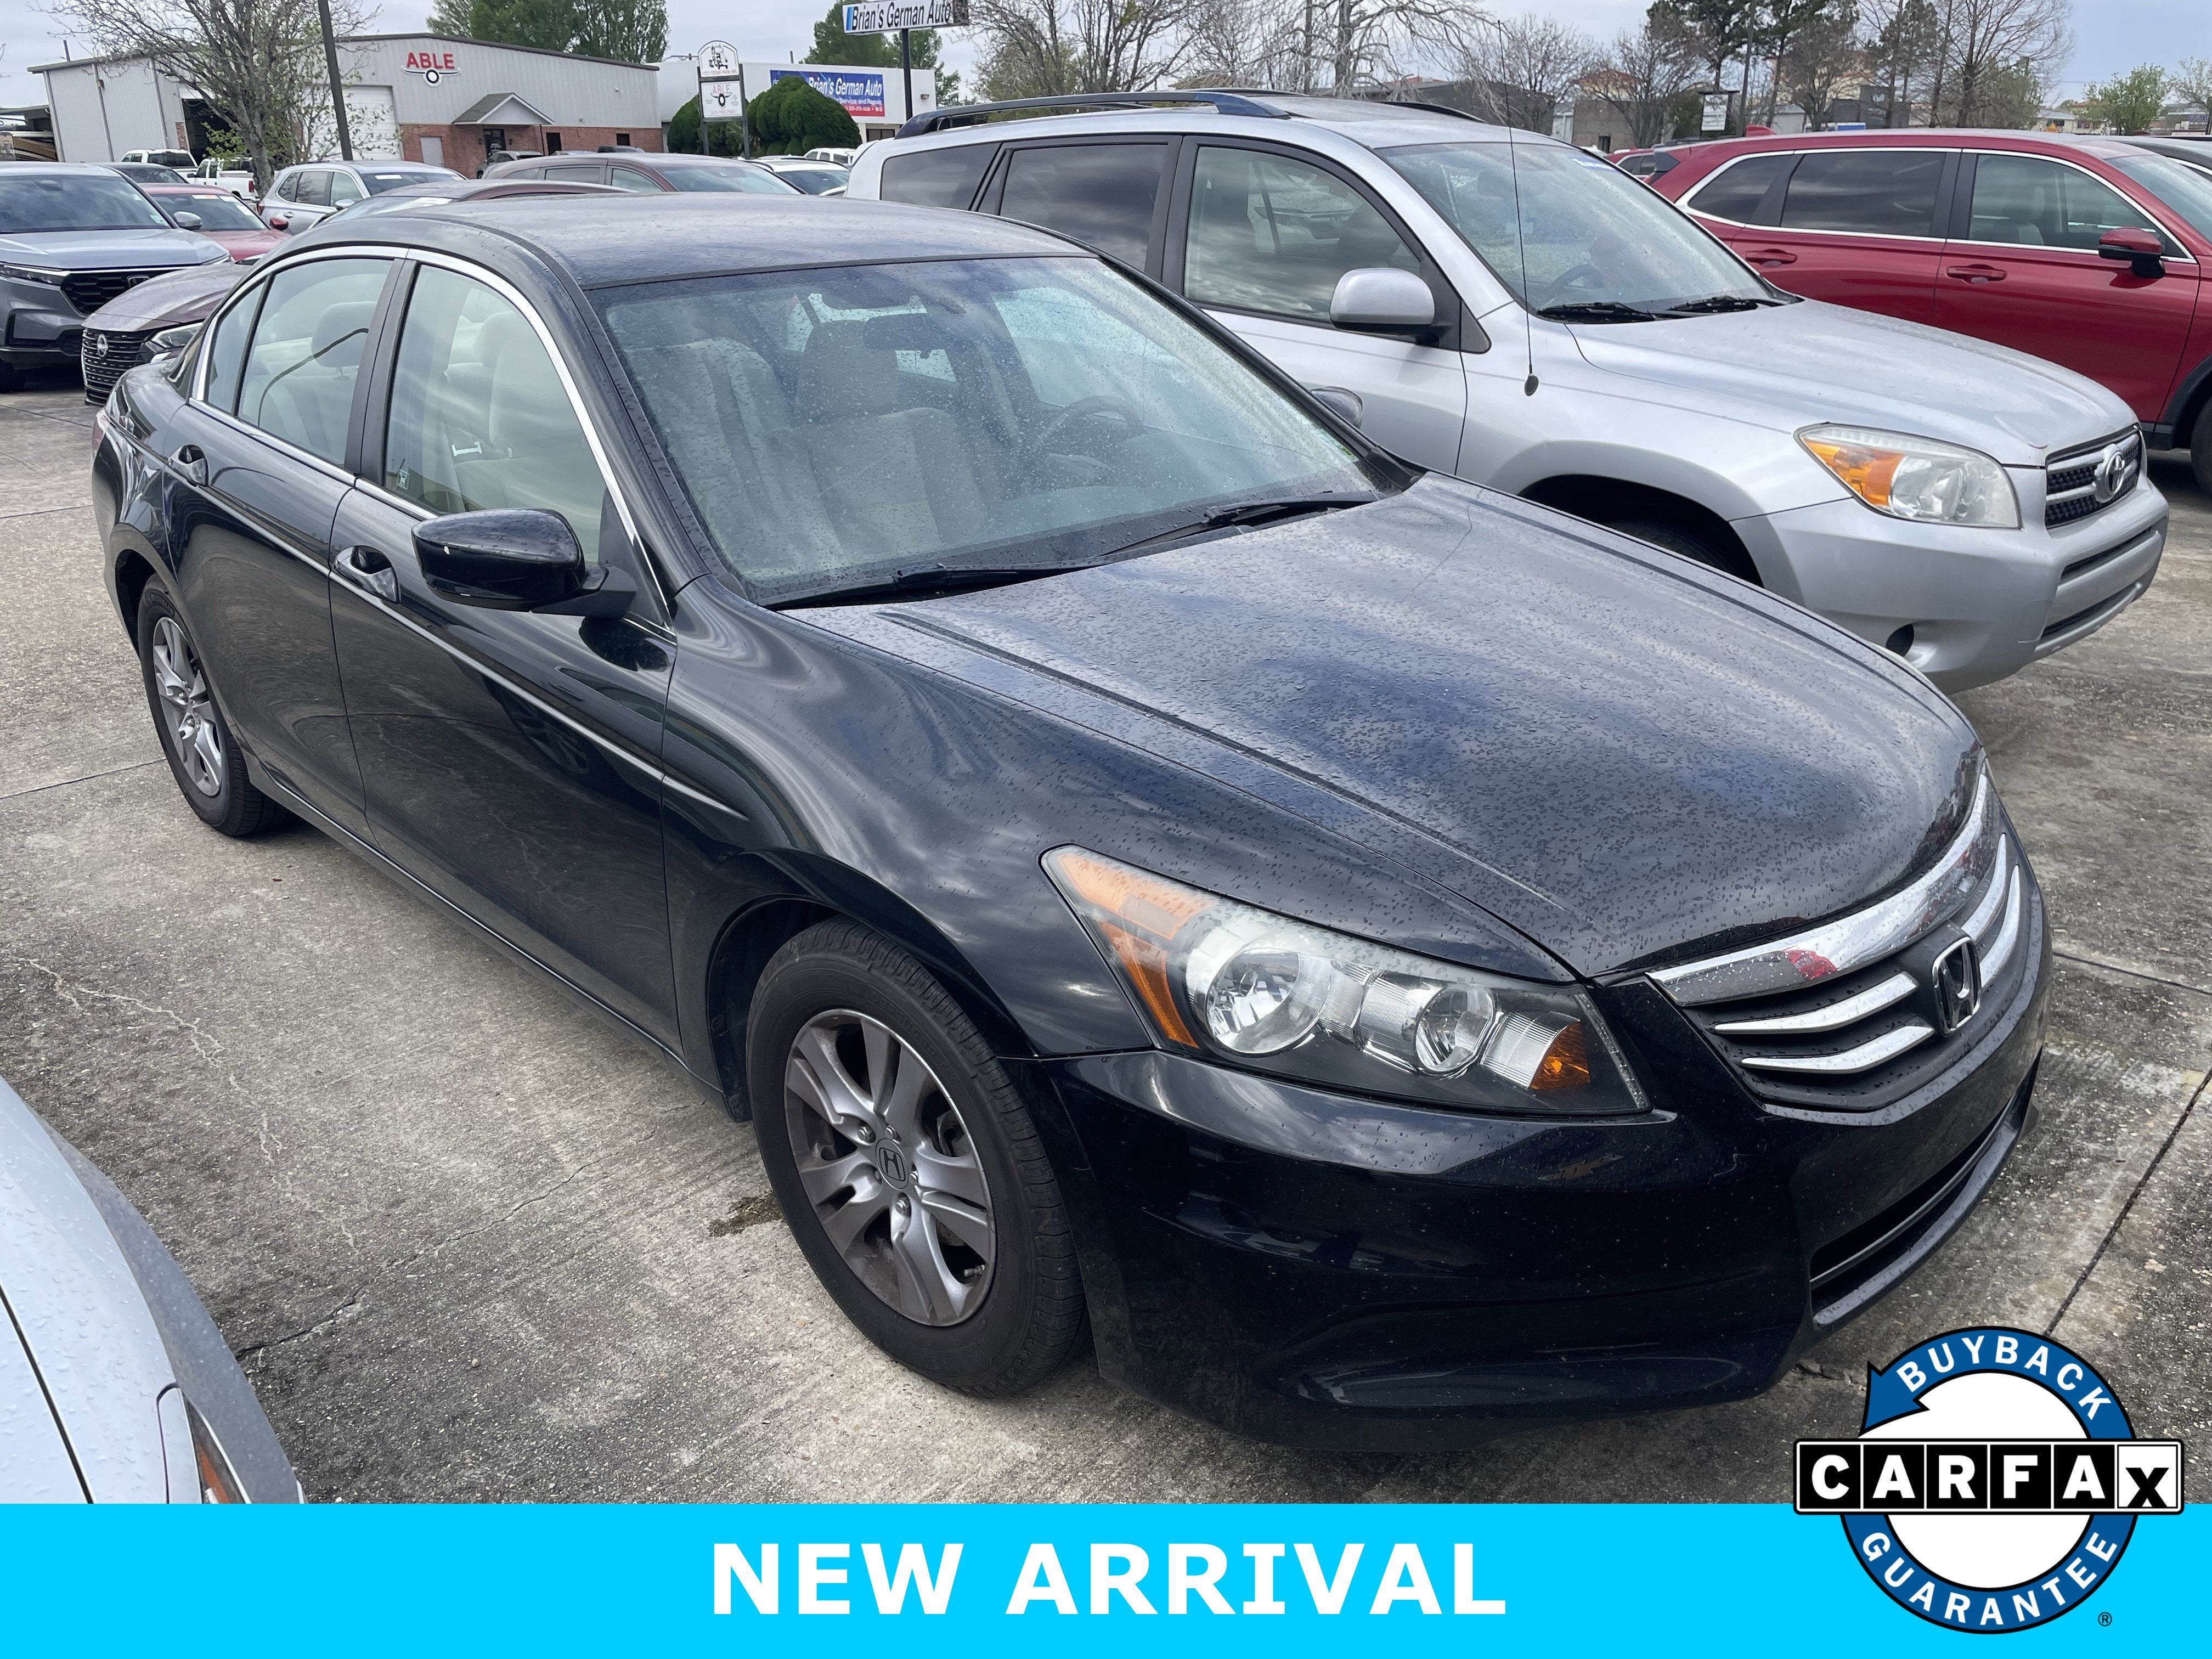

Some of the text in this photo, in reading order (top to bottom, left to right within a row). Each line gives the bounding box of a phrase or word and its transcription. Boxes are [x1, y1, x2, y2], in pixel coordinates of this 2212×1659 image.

[851, 1, 951, 31] Brian's German Auto
[407, 52, 455, 69] ABLE
[713, 84, 730, 94] ABLE
[808, 77, 882, 97] Brian's German Auto
